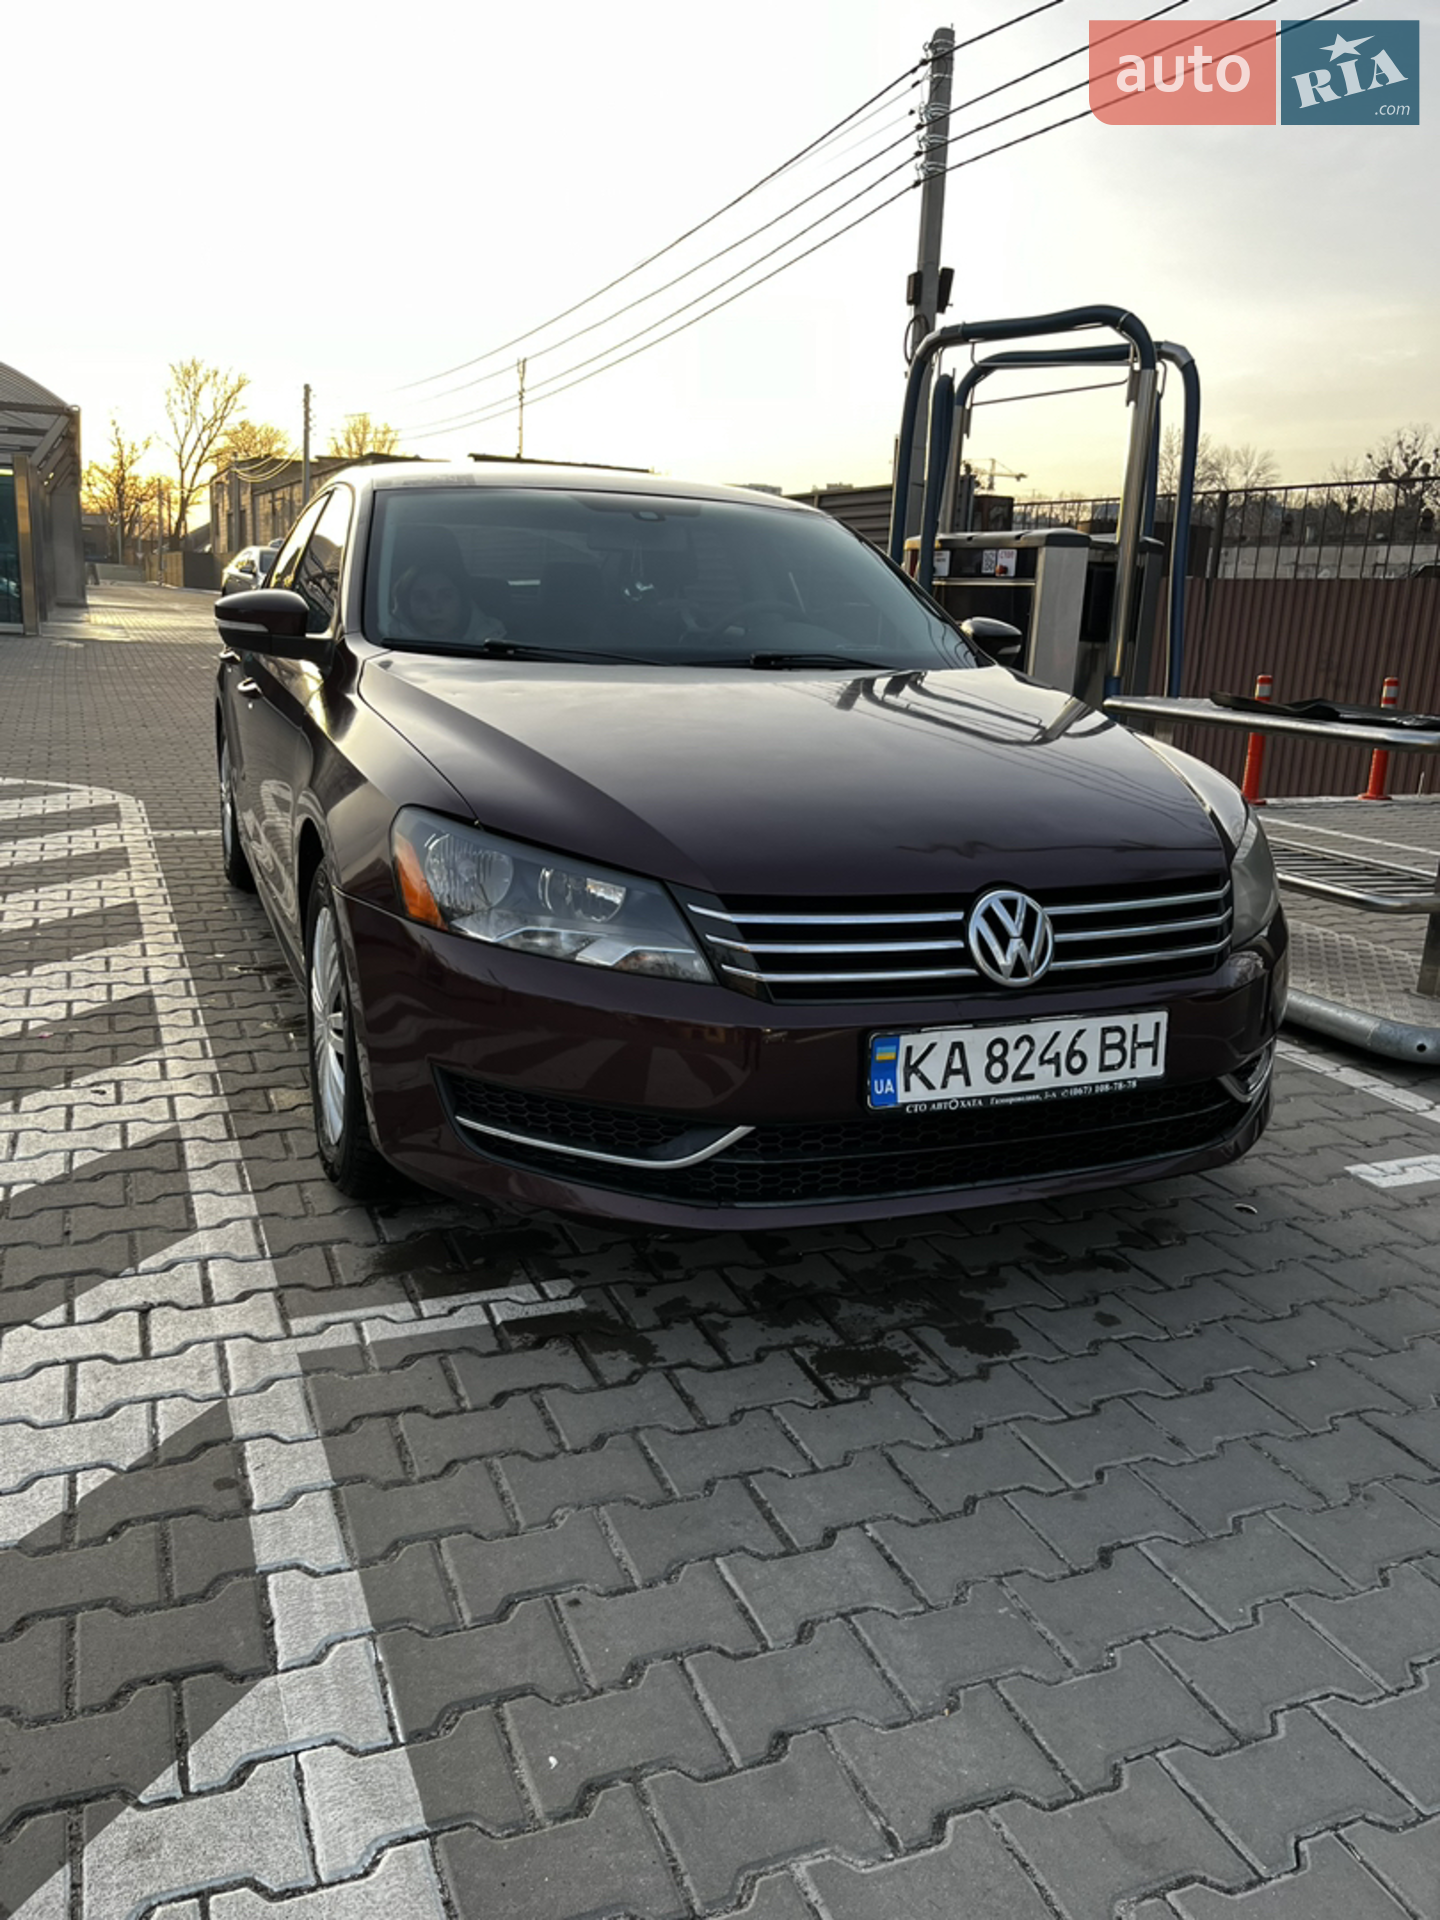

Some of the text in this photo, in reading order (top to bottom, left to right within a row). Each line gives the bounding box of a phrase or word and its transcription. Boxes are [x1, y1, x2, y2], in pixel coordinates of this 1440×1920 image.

[903, 1021, 1161, 1093] KA 8246 BH
[874, 1078, 895, 1095] UA
